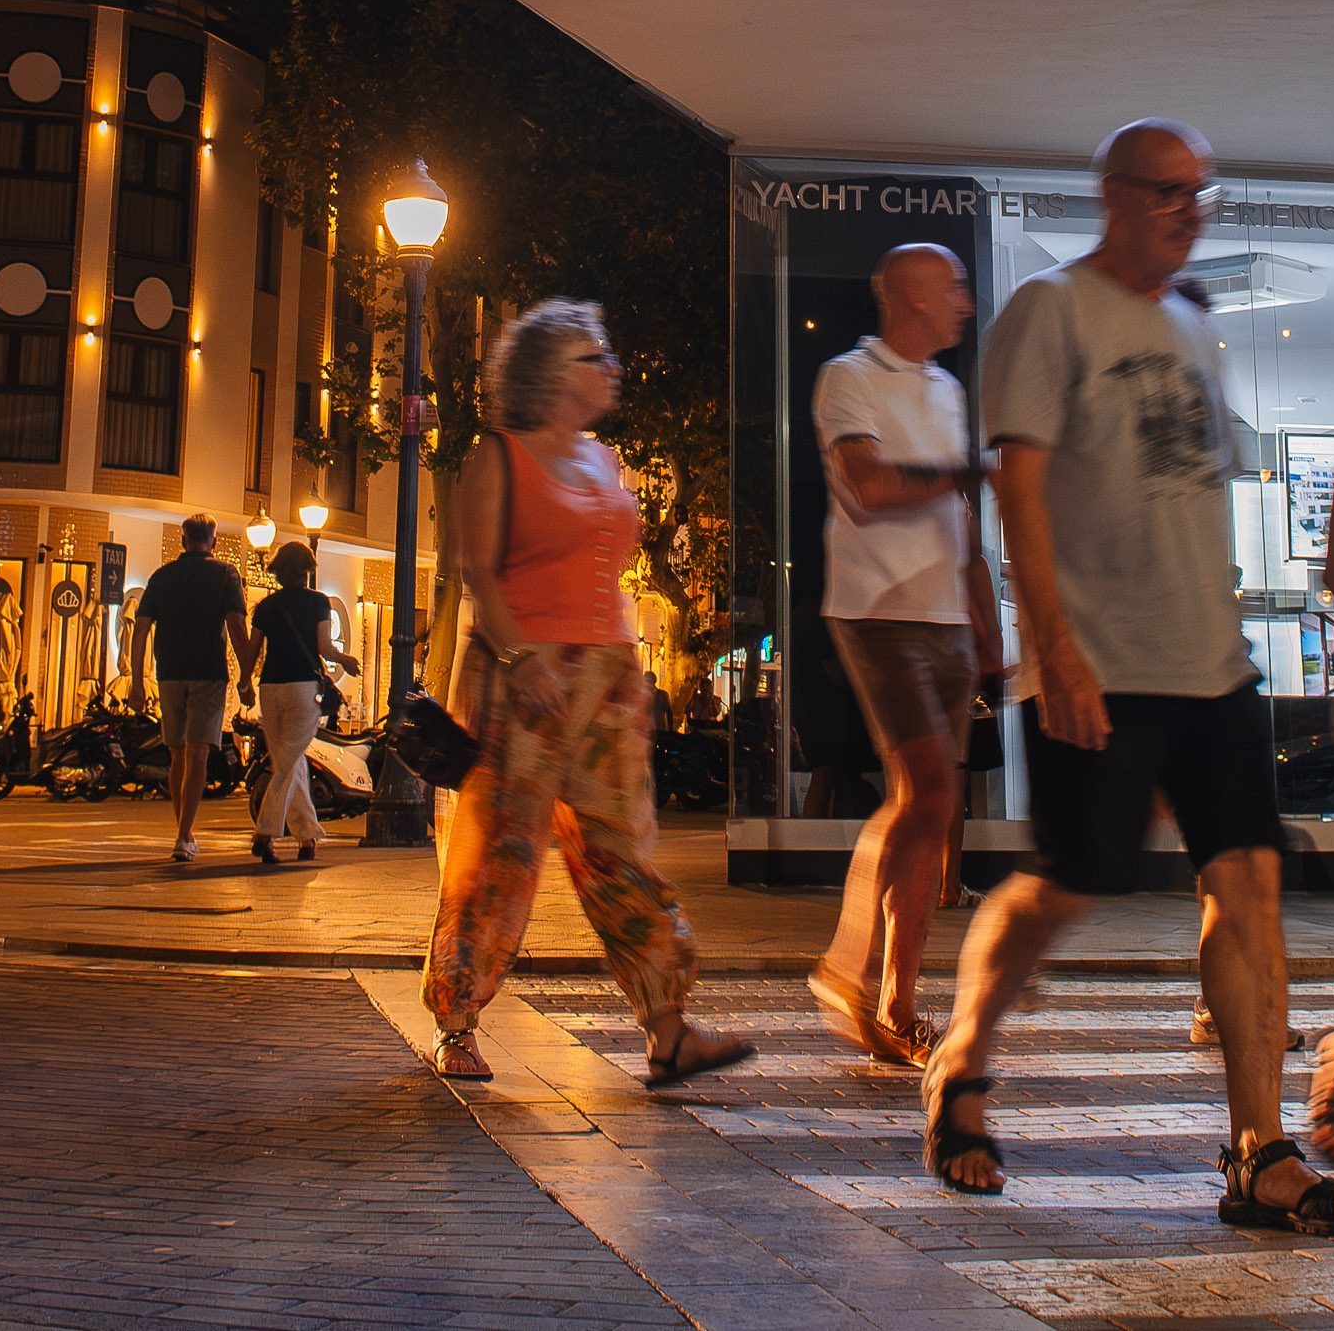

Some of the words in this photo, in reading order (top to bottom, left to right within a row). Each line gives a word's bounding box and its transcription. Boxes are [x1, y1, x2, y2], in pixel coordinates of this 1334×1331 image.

[751, 180, 870, 212] YACHT
[879, 185, 1067, 220] CHARTERS
[105, 548, 124, 567] TAXI
